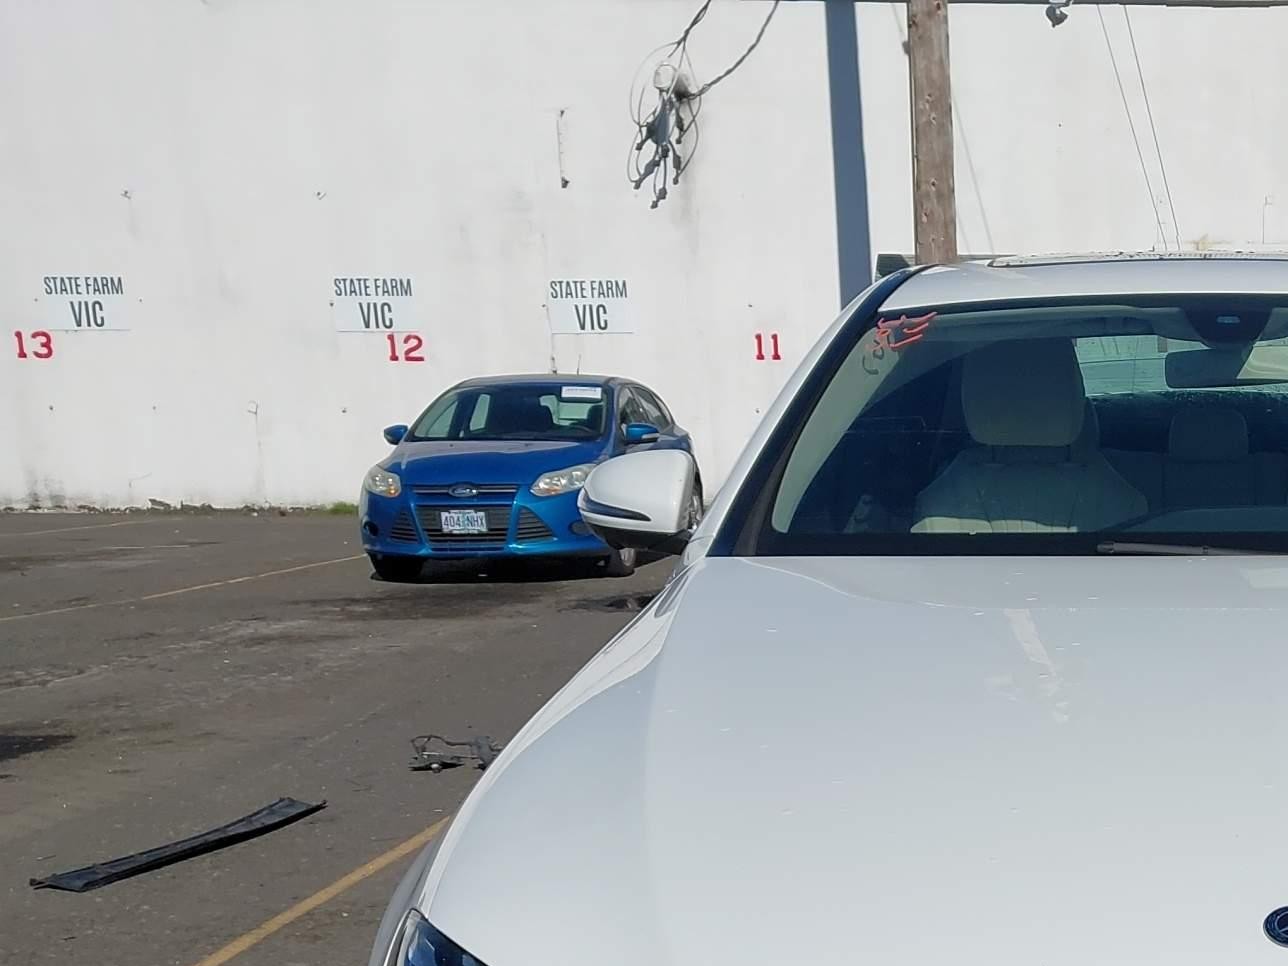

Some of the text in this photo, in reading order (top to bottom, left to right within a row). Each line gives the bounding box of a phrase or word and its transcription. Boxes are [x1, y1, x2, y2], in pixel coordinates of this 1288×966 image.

[43, 276, 124, 295] STATE FARM
[333, 278, 413, 297] STATE FARM
[549, 280, 628, 299] STATE FARM
[69, 300, 105, 328] VIC
[358, 302, 394, 329] VIC
[574, 304, 609, 331] VIC
[14, 330, 54, 359] 13
[386, 333, 425, 363] 12
[755, 333, 782, 361] 11
[443, 515, 461, 528] 404
